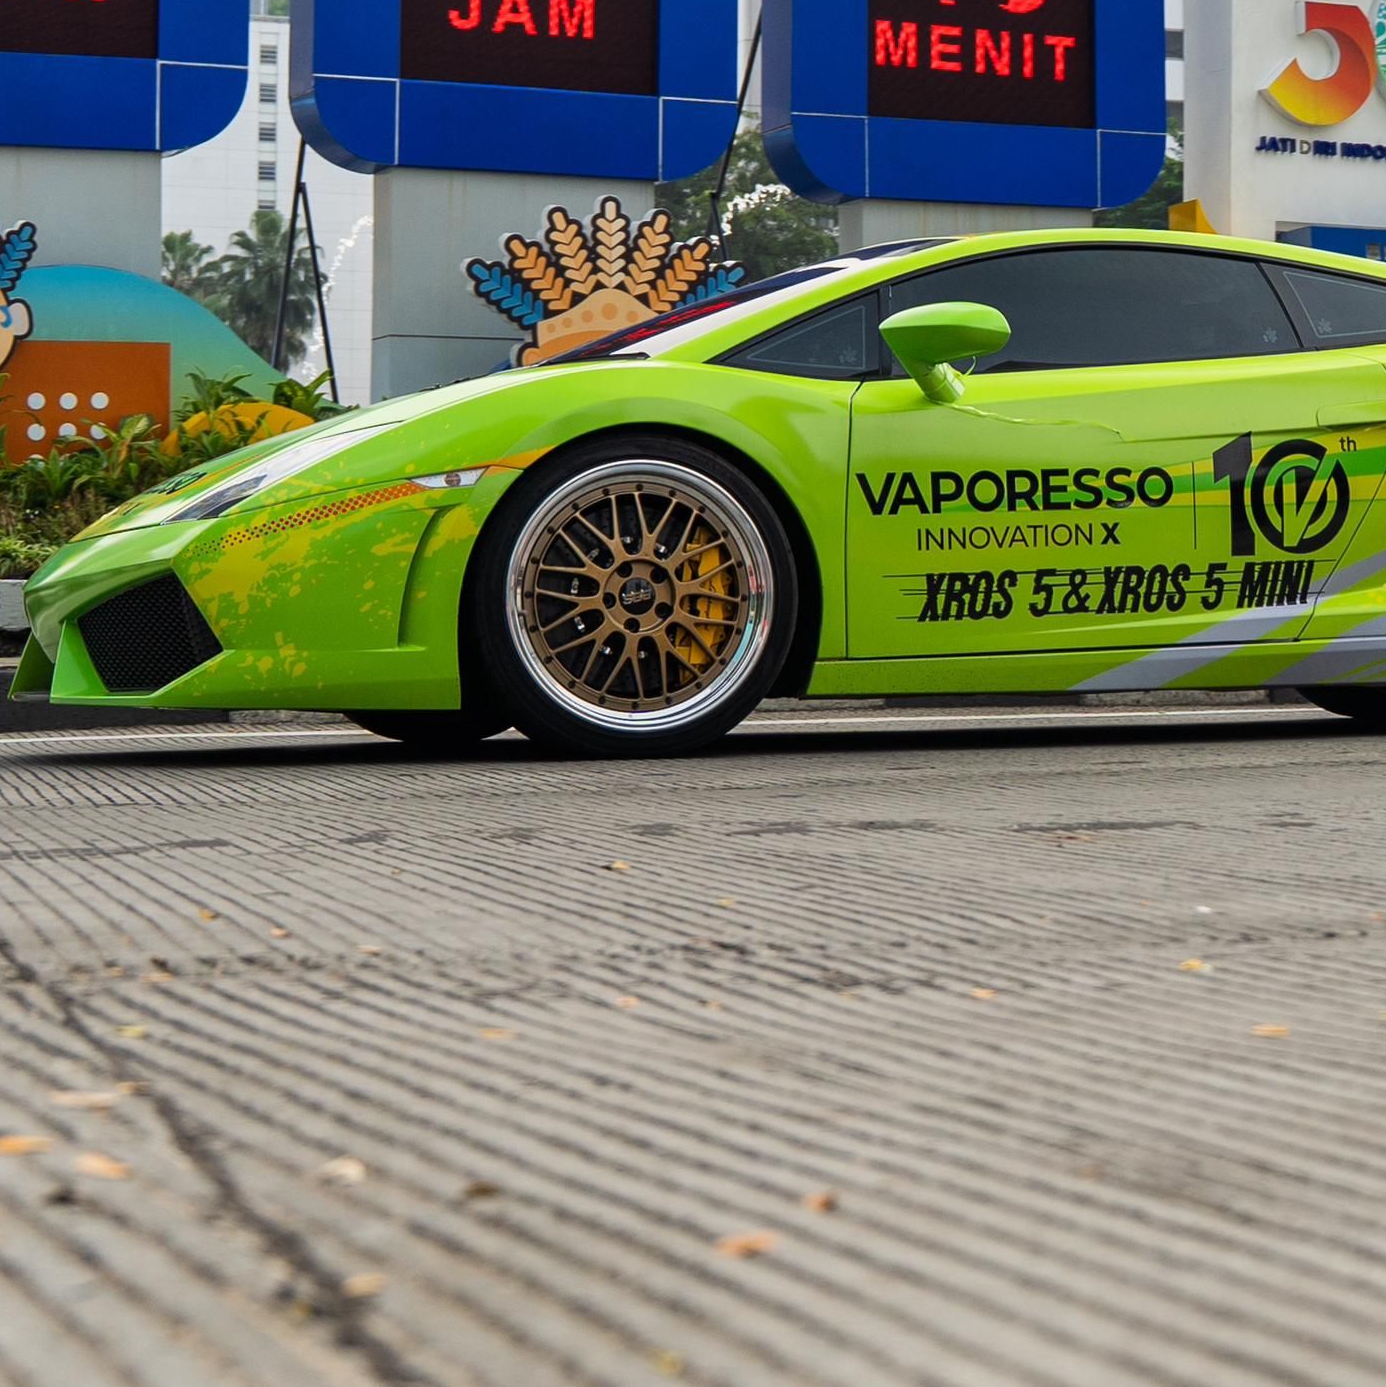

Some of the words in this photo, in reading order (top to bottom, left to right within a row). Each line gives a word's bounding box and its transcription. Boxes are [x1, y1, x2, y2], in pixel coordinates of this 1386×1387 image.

[875, 19, 1076, 81] MENIT
[1255, 135, 1297, 154] JATI
[855, 466, 1174, 516] VAPORESSO
[916, 522, 1093, 551] INNOVATION
[1100, 522, 1121, 545] X
[916, 569, 1018, 623] XROS
[1236, 559, 1315, 609] MINI
